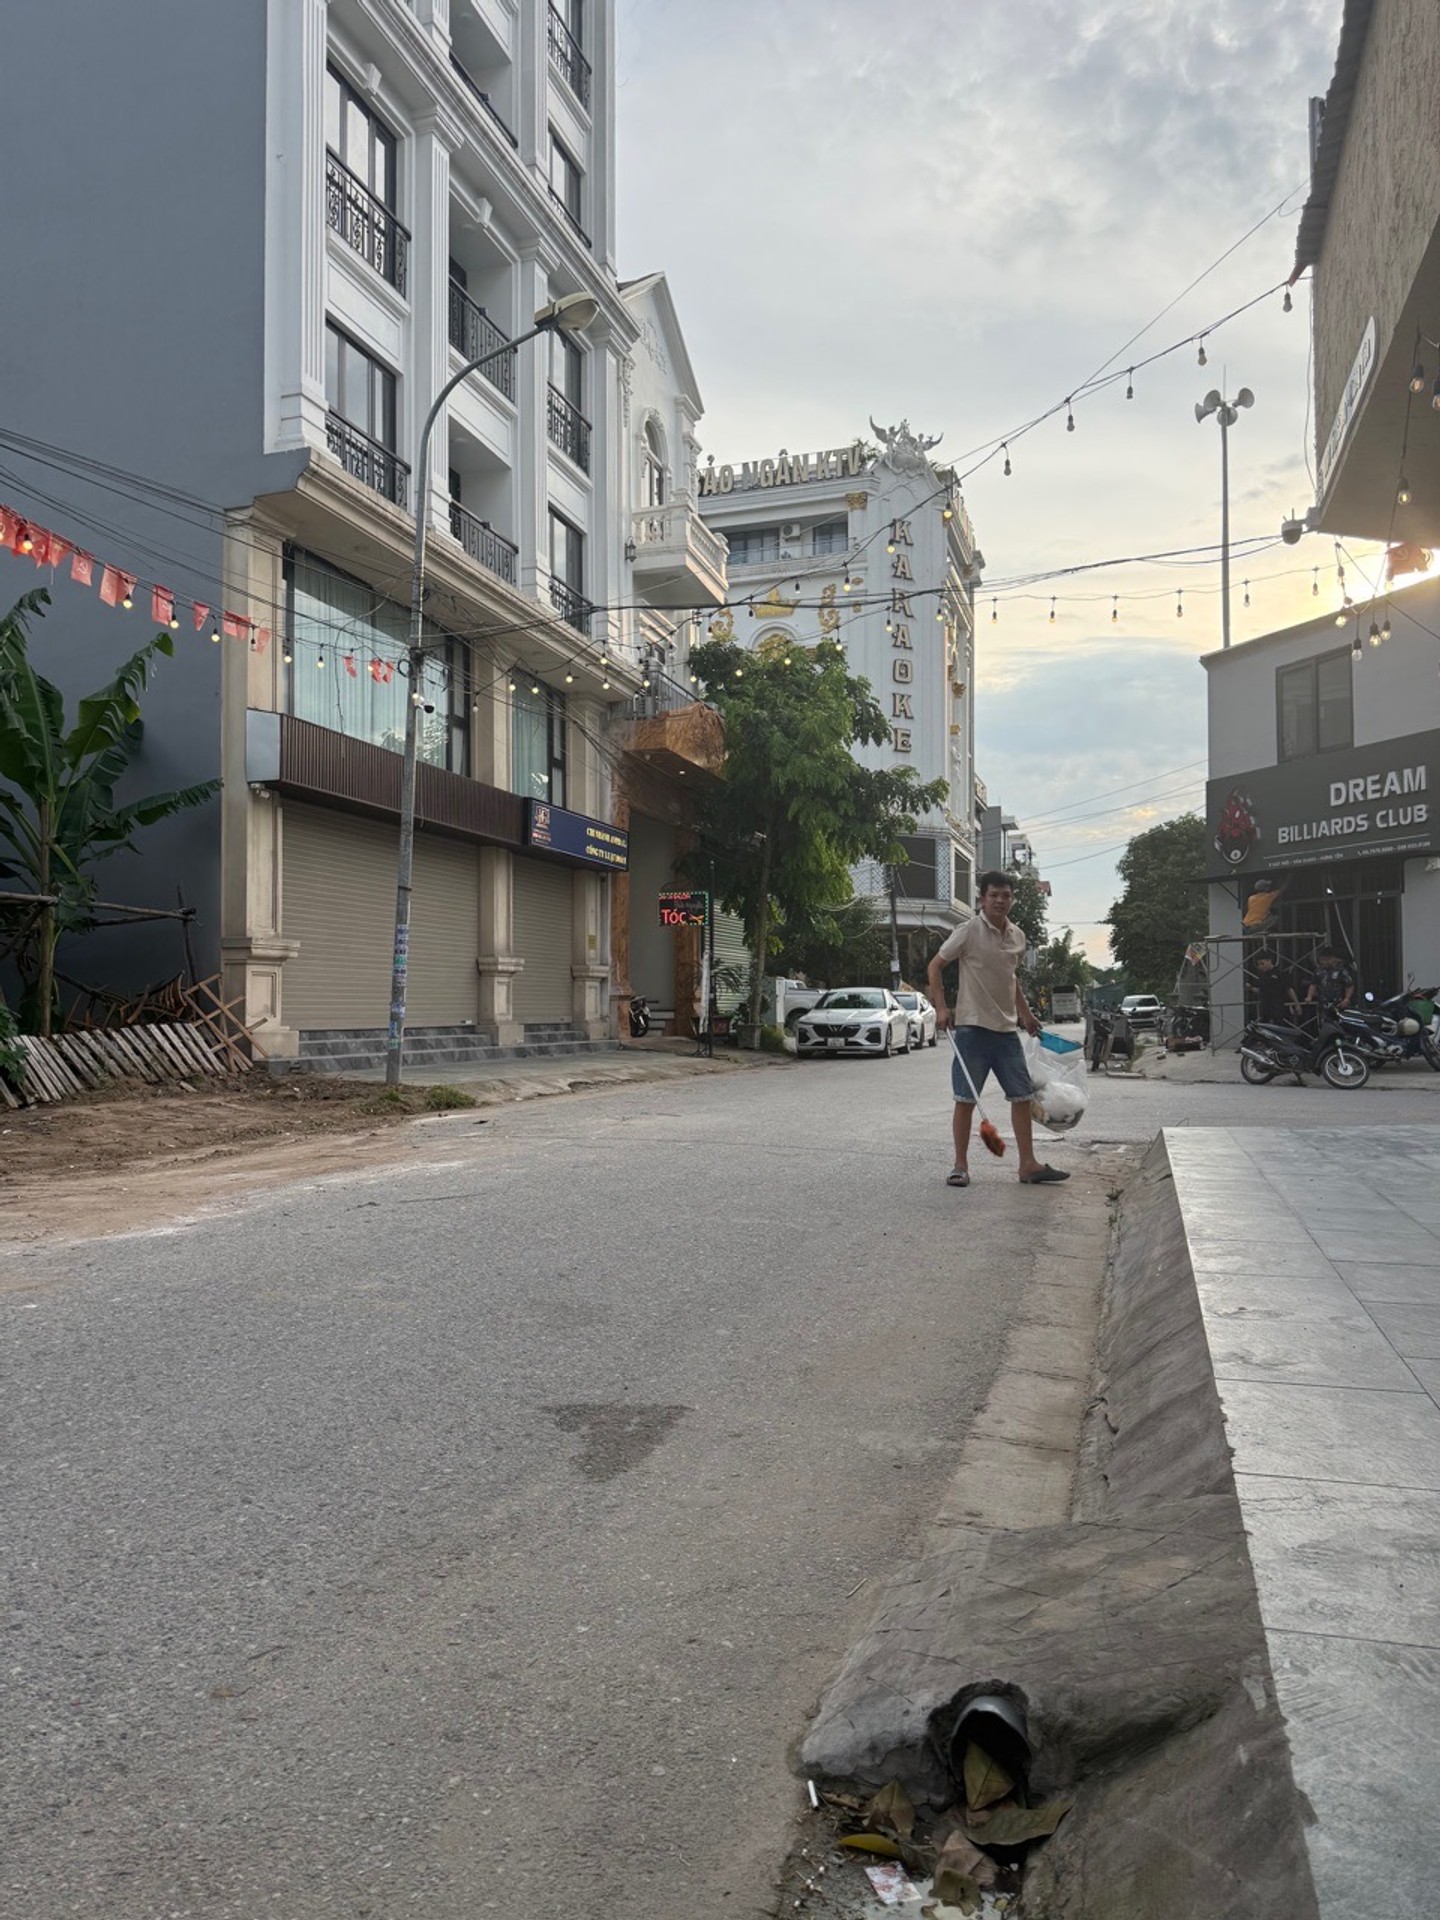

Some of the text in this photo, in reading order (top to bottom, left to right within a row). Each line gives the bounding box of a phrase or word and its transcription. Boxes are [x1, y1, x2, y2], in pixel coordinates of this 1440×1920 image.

[742, 448, 810, 491] NGÂN
[816, 447, 861, 481] KTV
[891, 518, 914, 753] KARAOKE
[1330, 765, 1427, 807] DREAM
[1278, 804, 1429, 844] BILLIARDS CLUB
